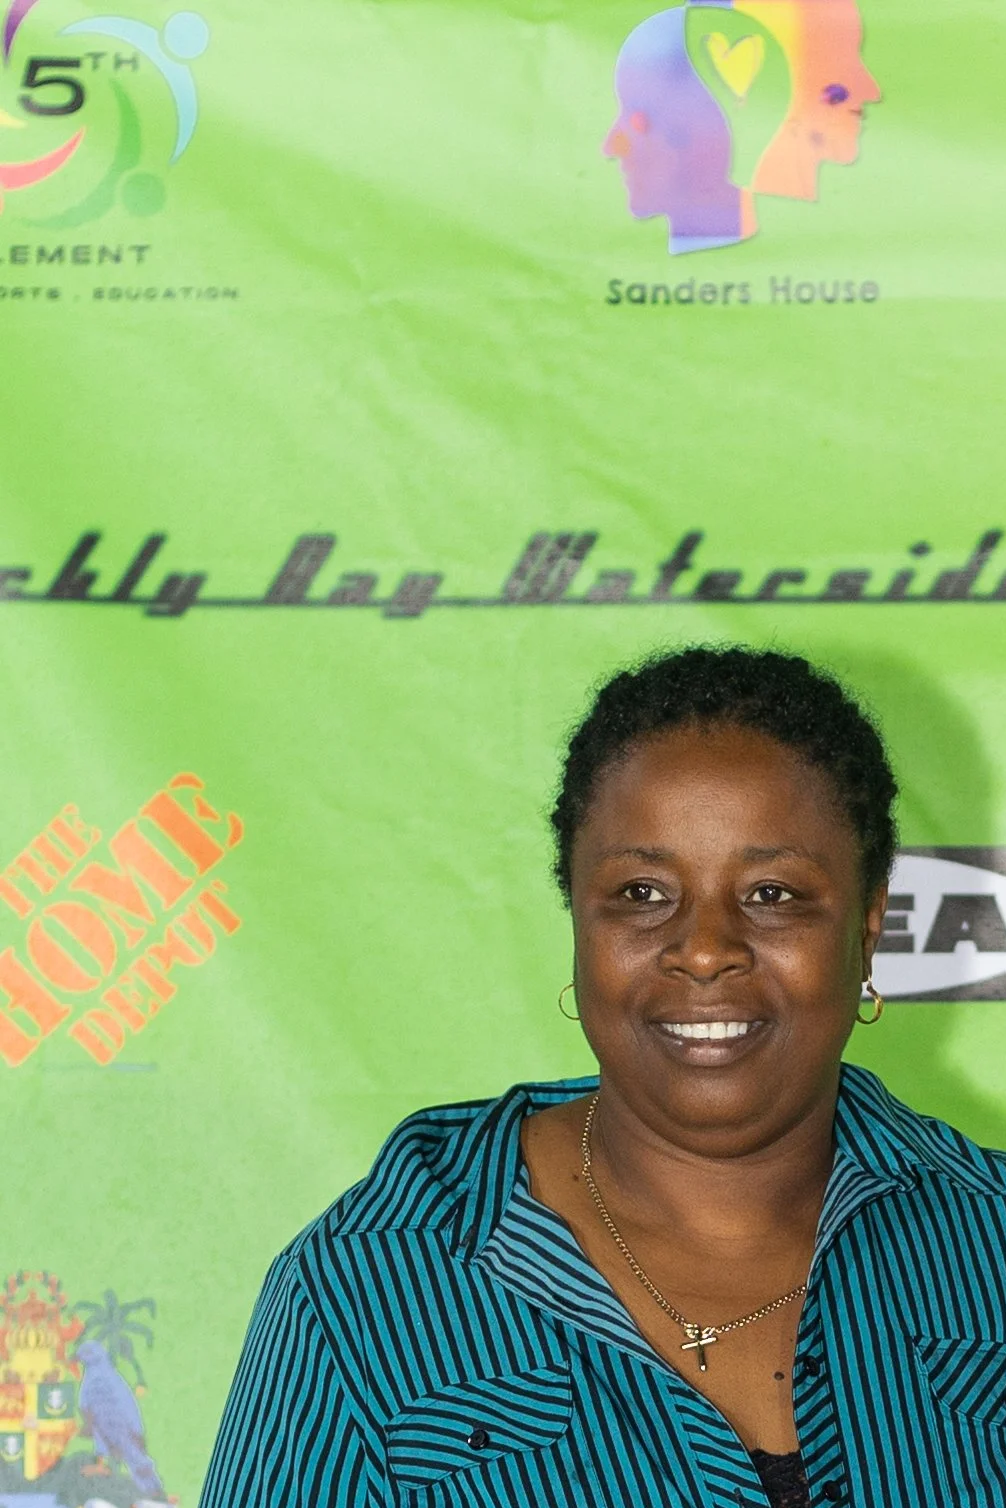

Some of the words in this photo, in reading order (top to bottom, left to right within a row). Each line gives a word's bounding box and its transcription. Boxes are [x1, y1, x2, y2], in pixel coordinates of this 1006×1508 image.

[18, 51, 141, 116] 5TH
[0, 245, 151, 265] EMENT
[93, 285, 240, 301] EDUCATION
[606, 278, 751, 306] Sanders
[769, 276, 881, 304] House
[68, 880, 243, 1066] DEPOT
